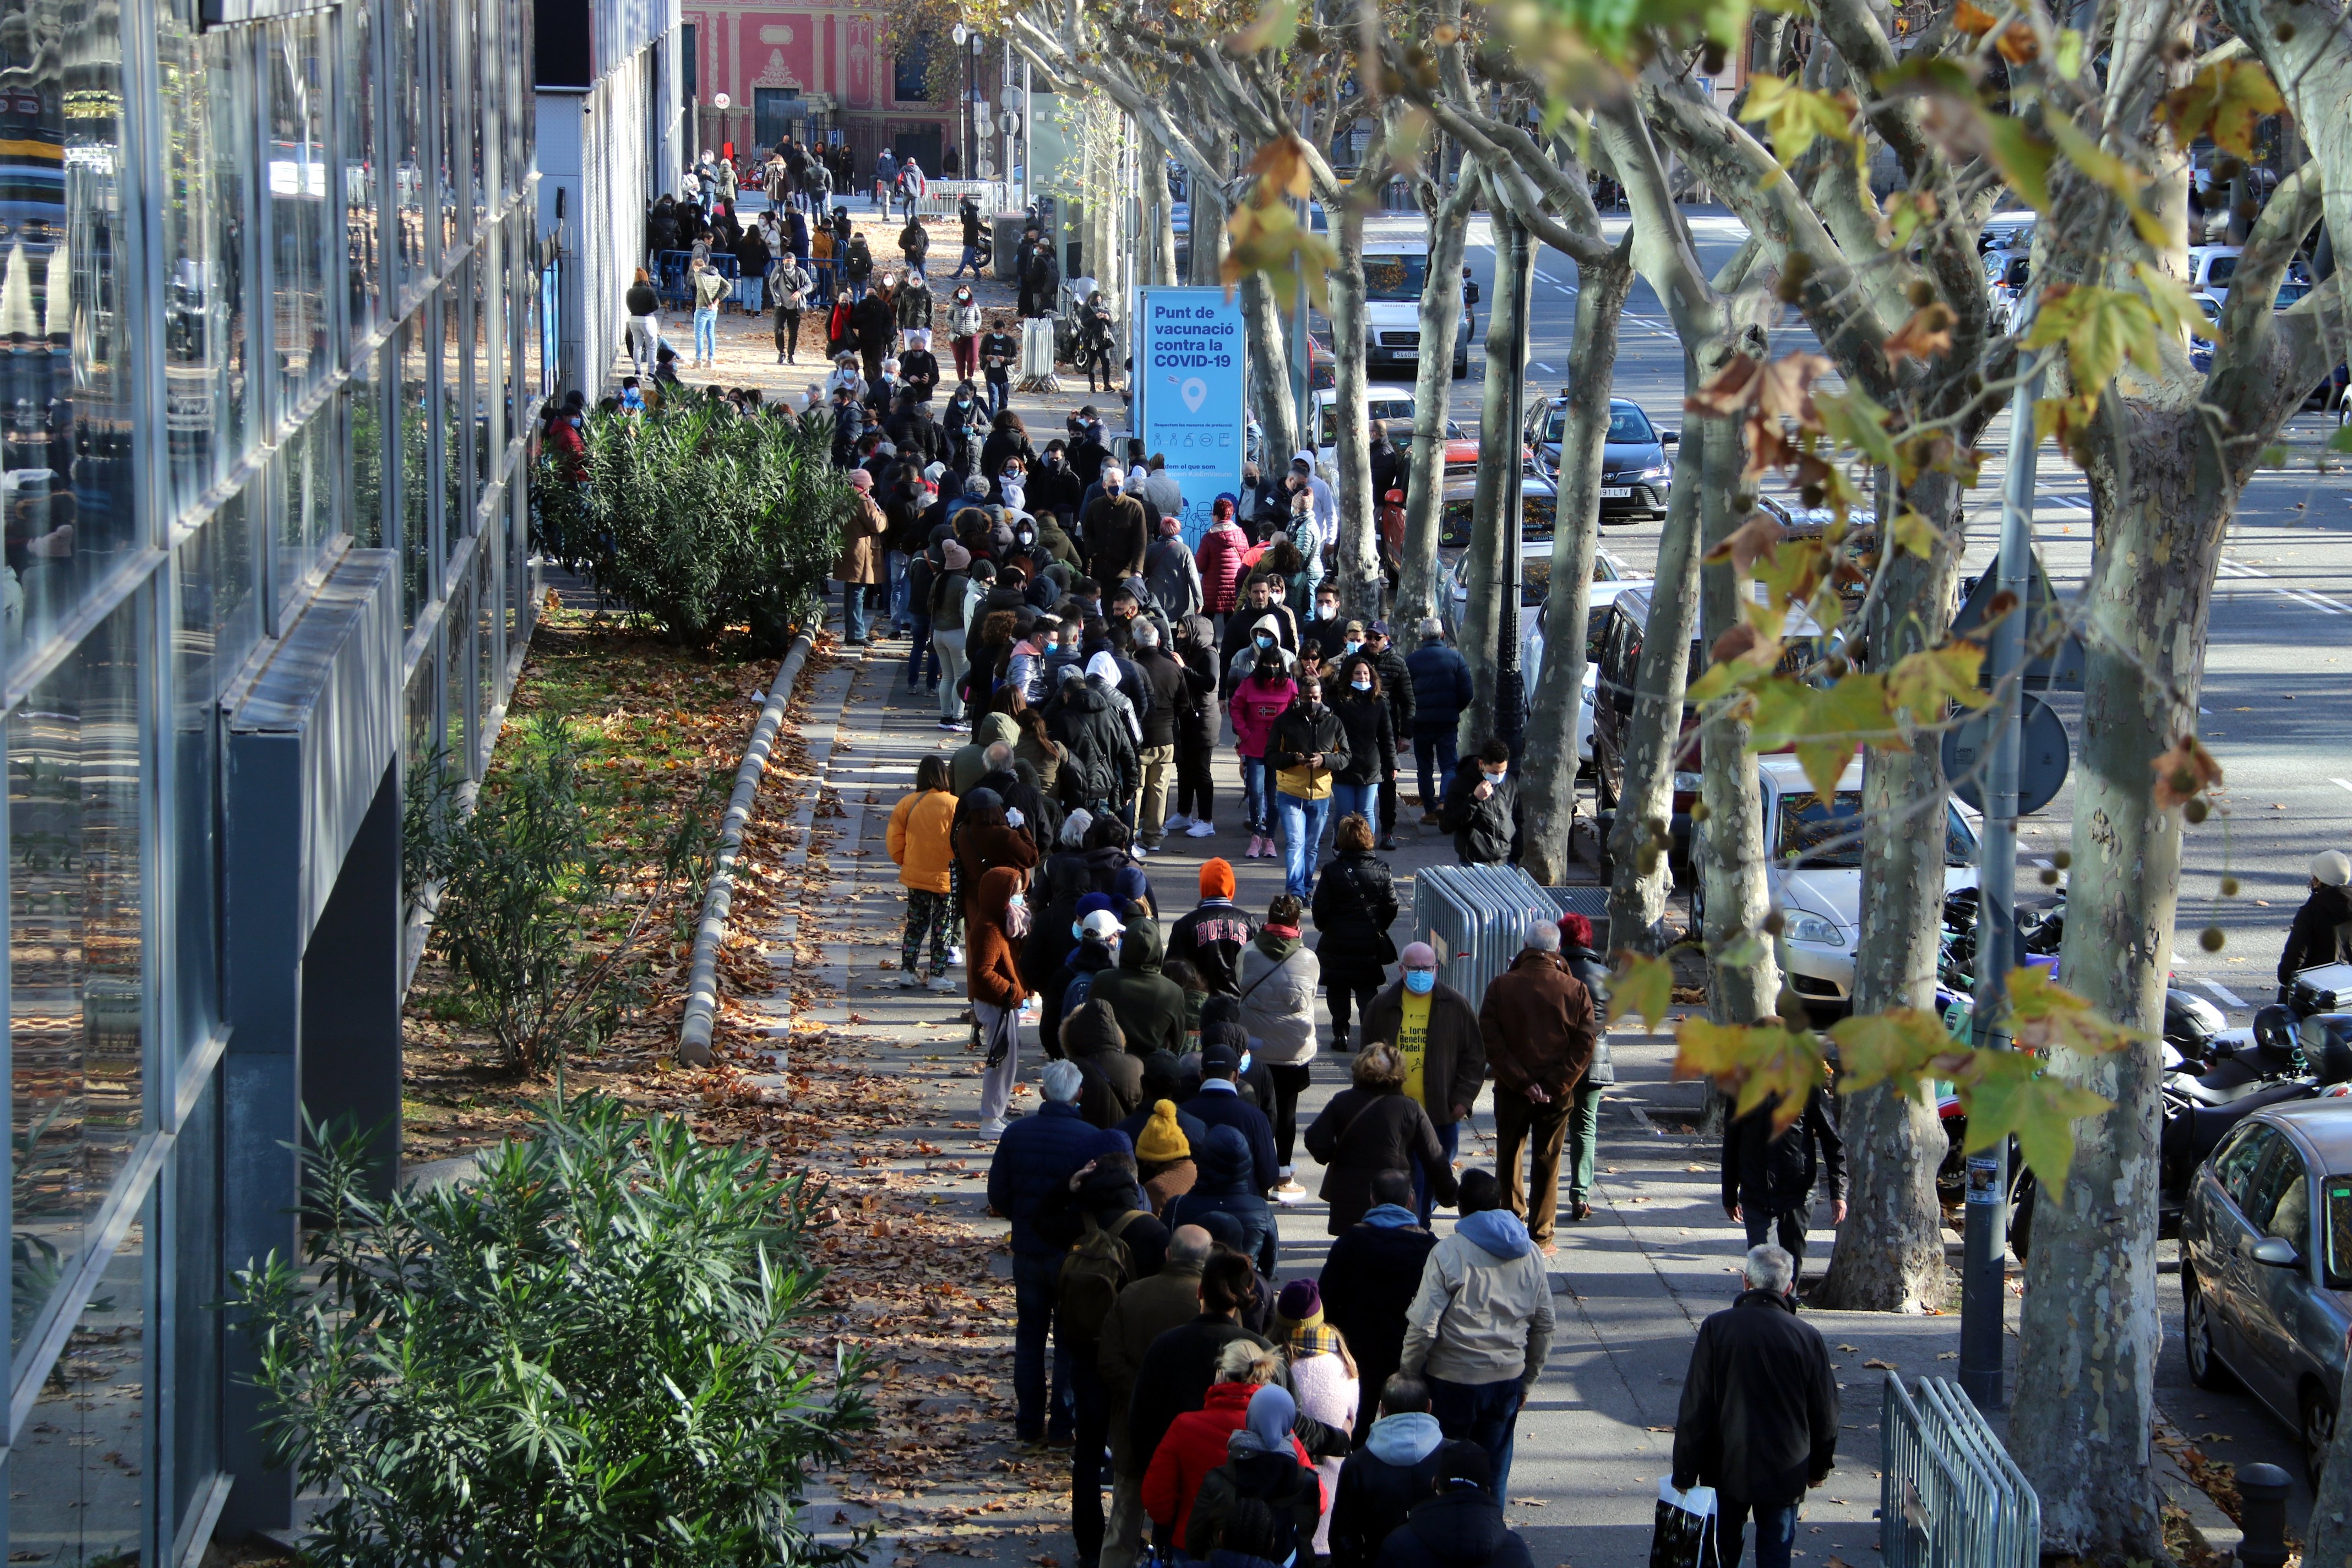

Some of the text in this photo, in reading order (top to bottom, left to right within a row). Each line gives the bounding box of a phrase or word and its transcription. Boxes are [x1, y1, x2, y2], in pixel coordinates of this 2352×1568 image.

[1155, 306, 1215, 318] Punt de
[1155, 323, 1234, 335] vacunació
[1155, 339, 1222, 351] contra la
[1154, 355, 1231, 367] COVID-19
[1196, 919, 1247, 947] BULLS
[1409, 1026, 1427, 1035] Torn
